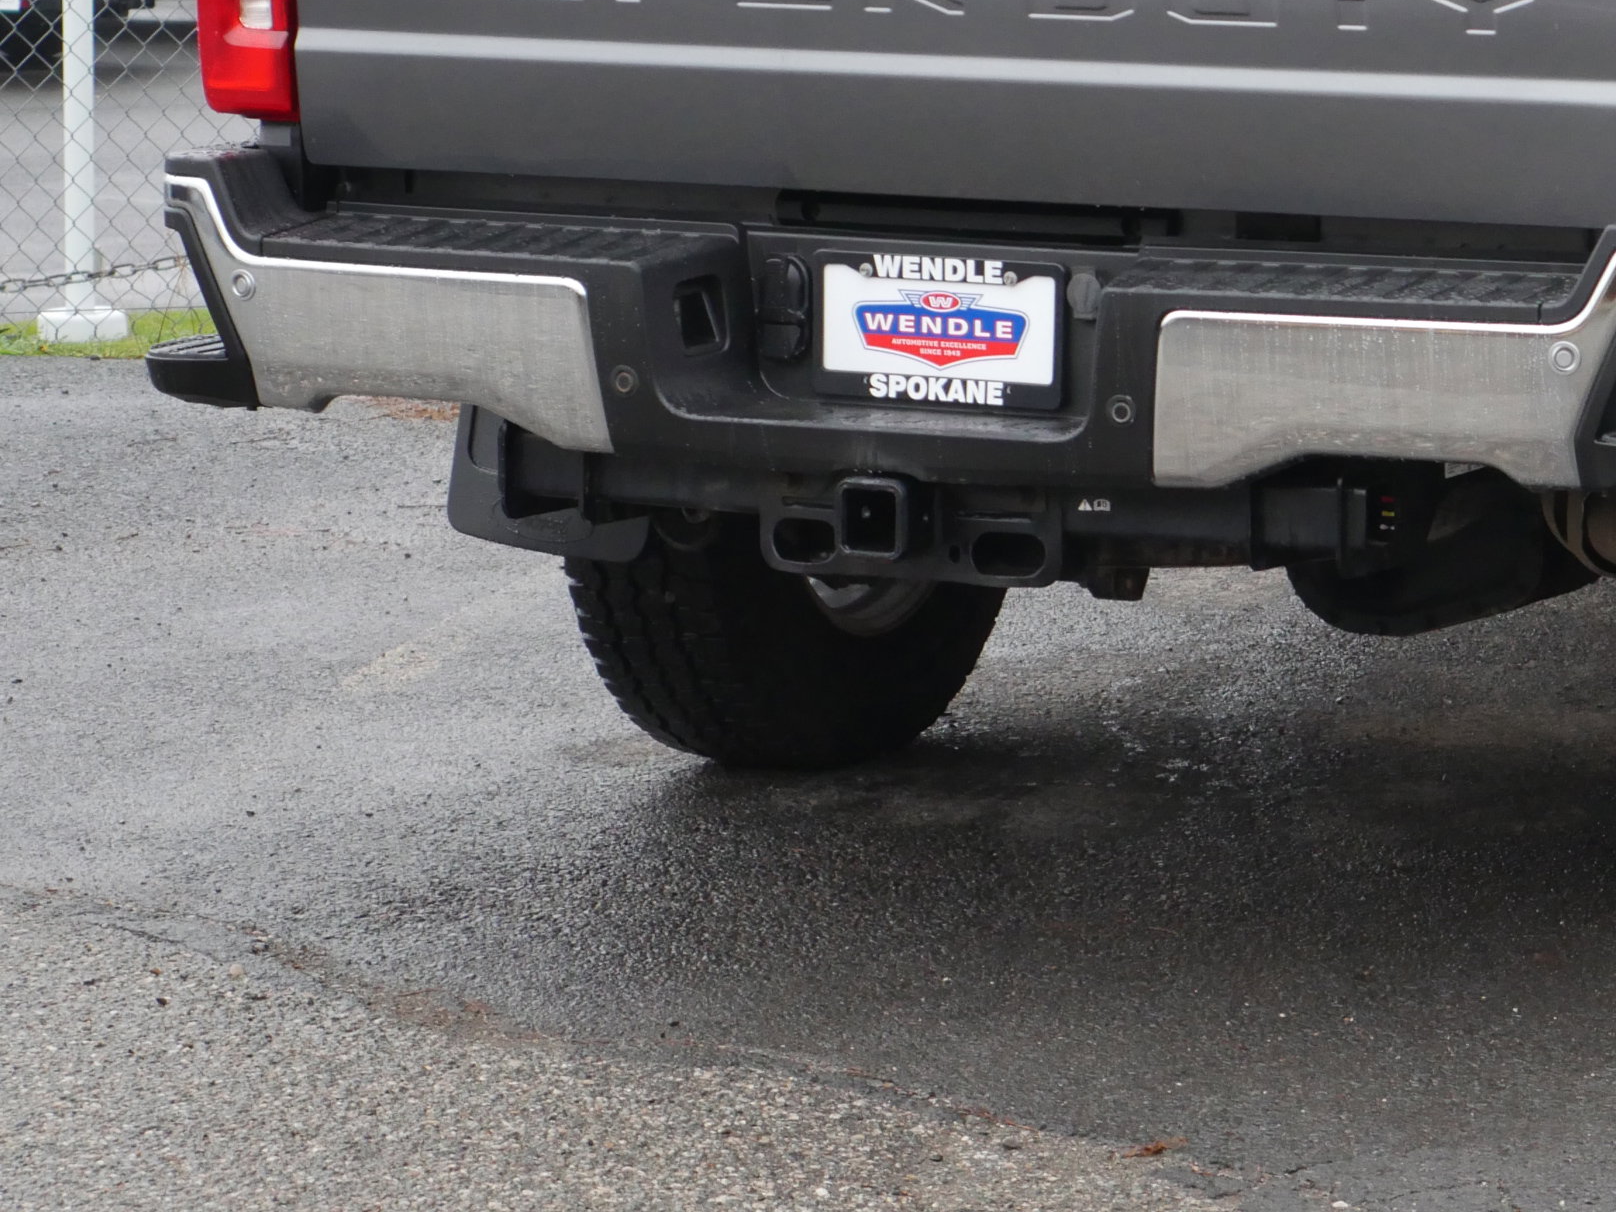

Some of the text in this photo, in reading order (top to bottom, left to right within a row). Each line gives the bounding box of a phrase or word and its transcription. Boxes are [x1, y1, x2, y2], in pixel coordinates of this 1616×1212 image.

[873, 254, 1005, 285] WENDLE
[864, 312, 1013, 339] WENDLE
[891, 338, 987, 350] AUTOMOTIVE EXCELLENCE
[919, 348, 942, 356] SINCE
[868, 373, 1005, 406] SPOKANE
